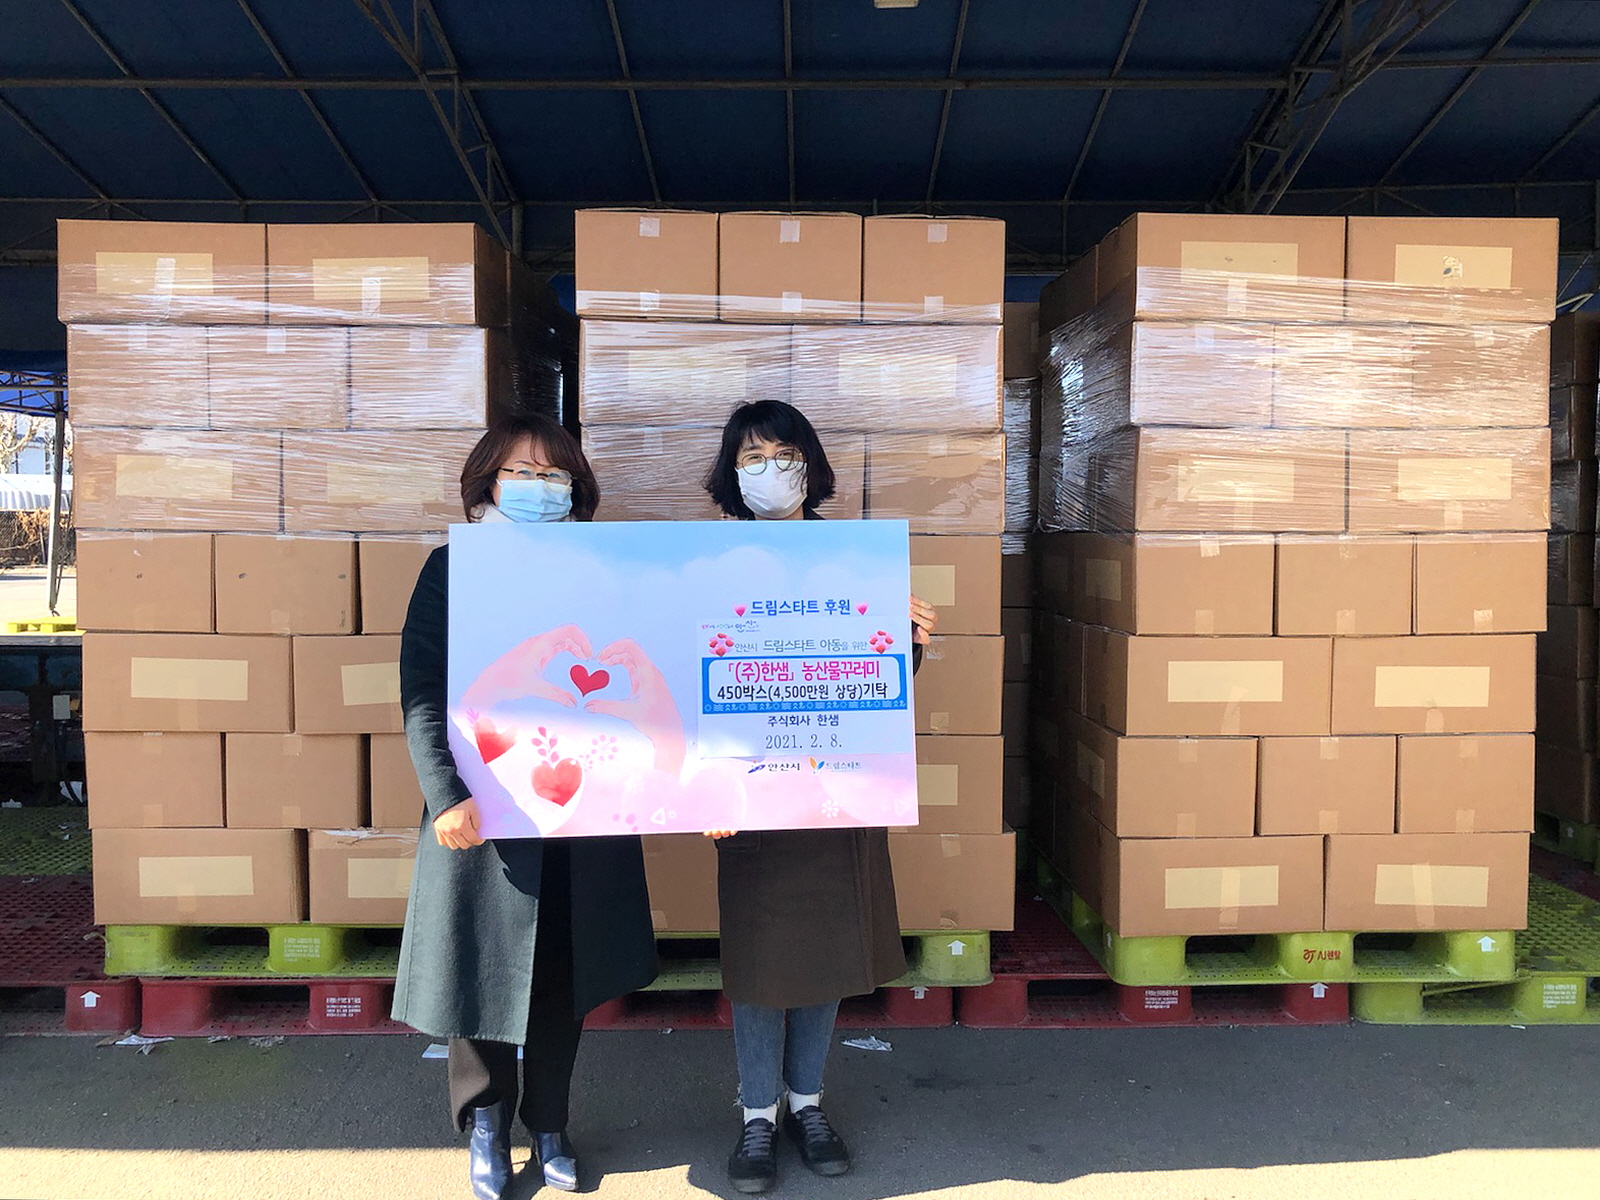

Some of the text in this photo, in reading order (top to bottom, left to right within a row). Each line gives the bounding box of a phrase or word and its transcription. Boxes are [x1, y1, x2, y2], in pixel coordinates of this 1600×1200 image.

[751, 599, 851, 616] 드림스타트 후원
[735, 639, 867, 652] 안산시 드림스타트 아동을 위한
[728, 660, 880, 683] 「(주)한샘」 농산물꾸러미
[717, 682, 888, 702] 450박스(4,500만원 상당)기탁
[767, 714, 839, 727] 주식회사 한샘
[765, 733, 842, 749] 2021. 2. 8.
[767, 762, 800, 772] 안산시
